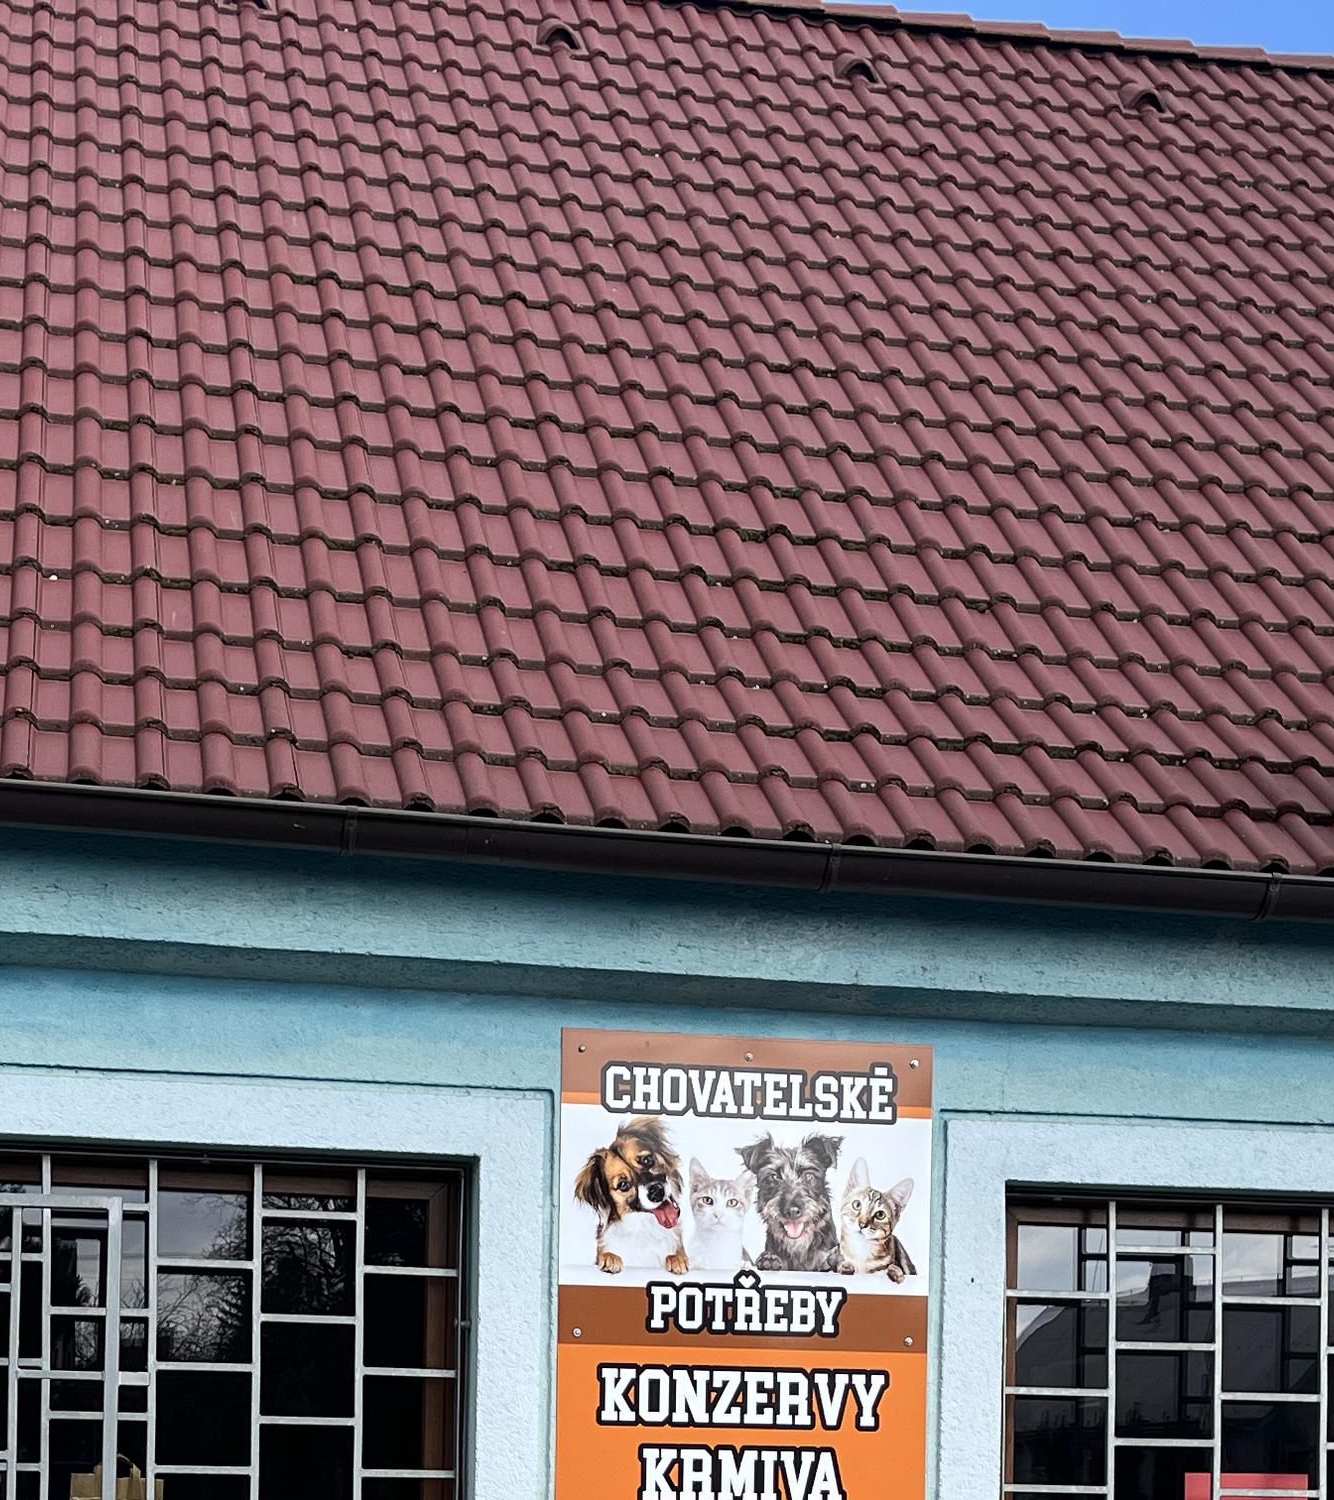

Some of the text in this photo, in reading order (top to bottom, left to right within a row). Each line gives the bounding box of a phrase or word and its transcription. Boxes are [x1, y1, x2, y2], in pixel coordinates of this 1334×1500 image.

[603, 1063, 895, 1122] CHOVATELSKÉ
[648, 1272, 844, 1335] POTŘEBY
[599, 1366, 887, 1429] KONZERVY
